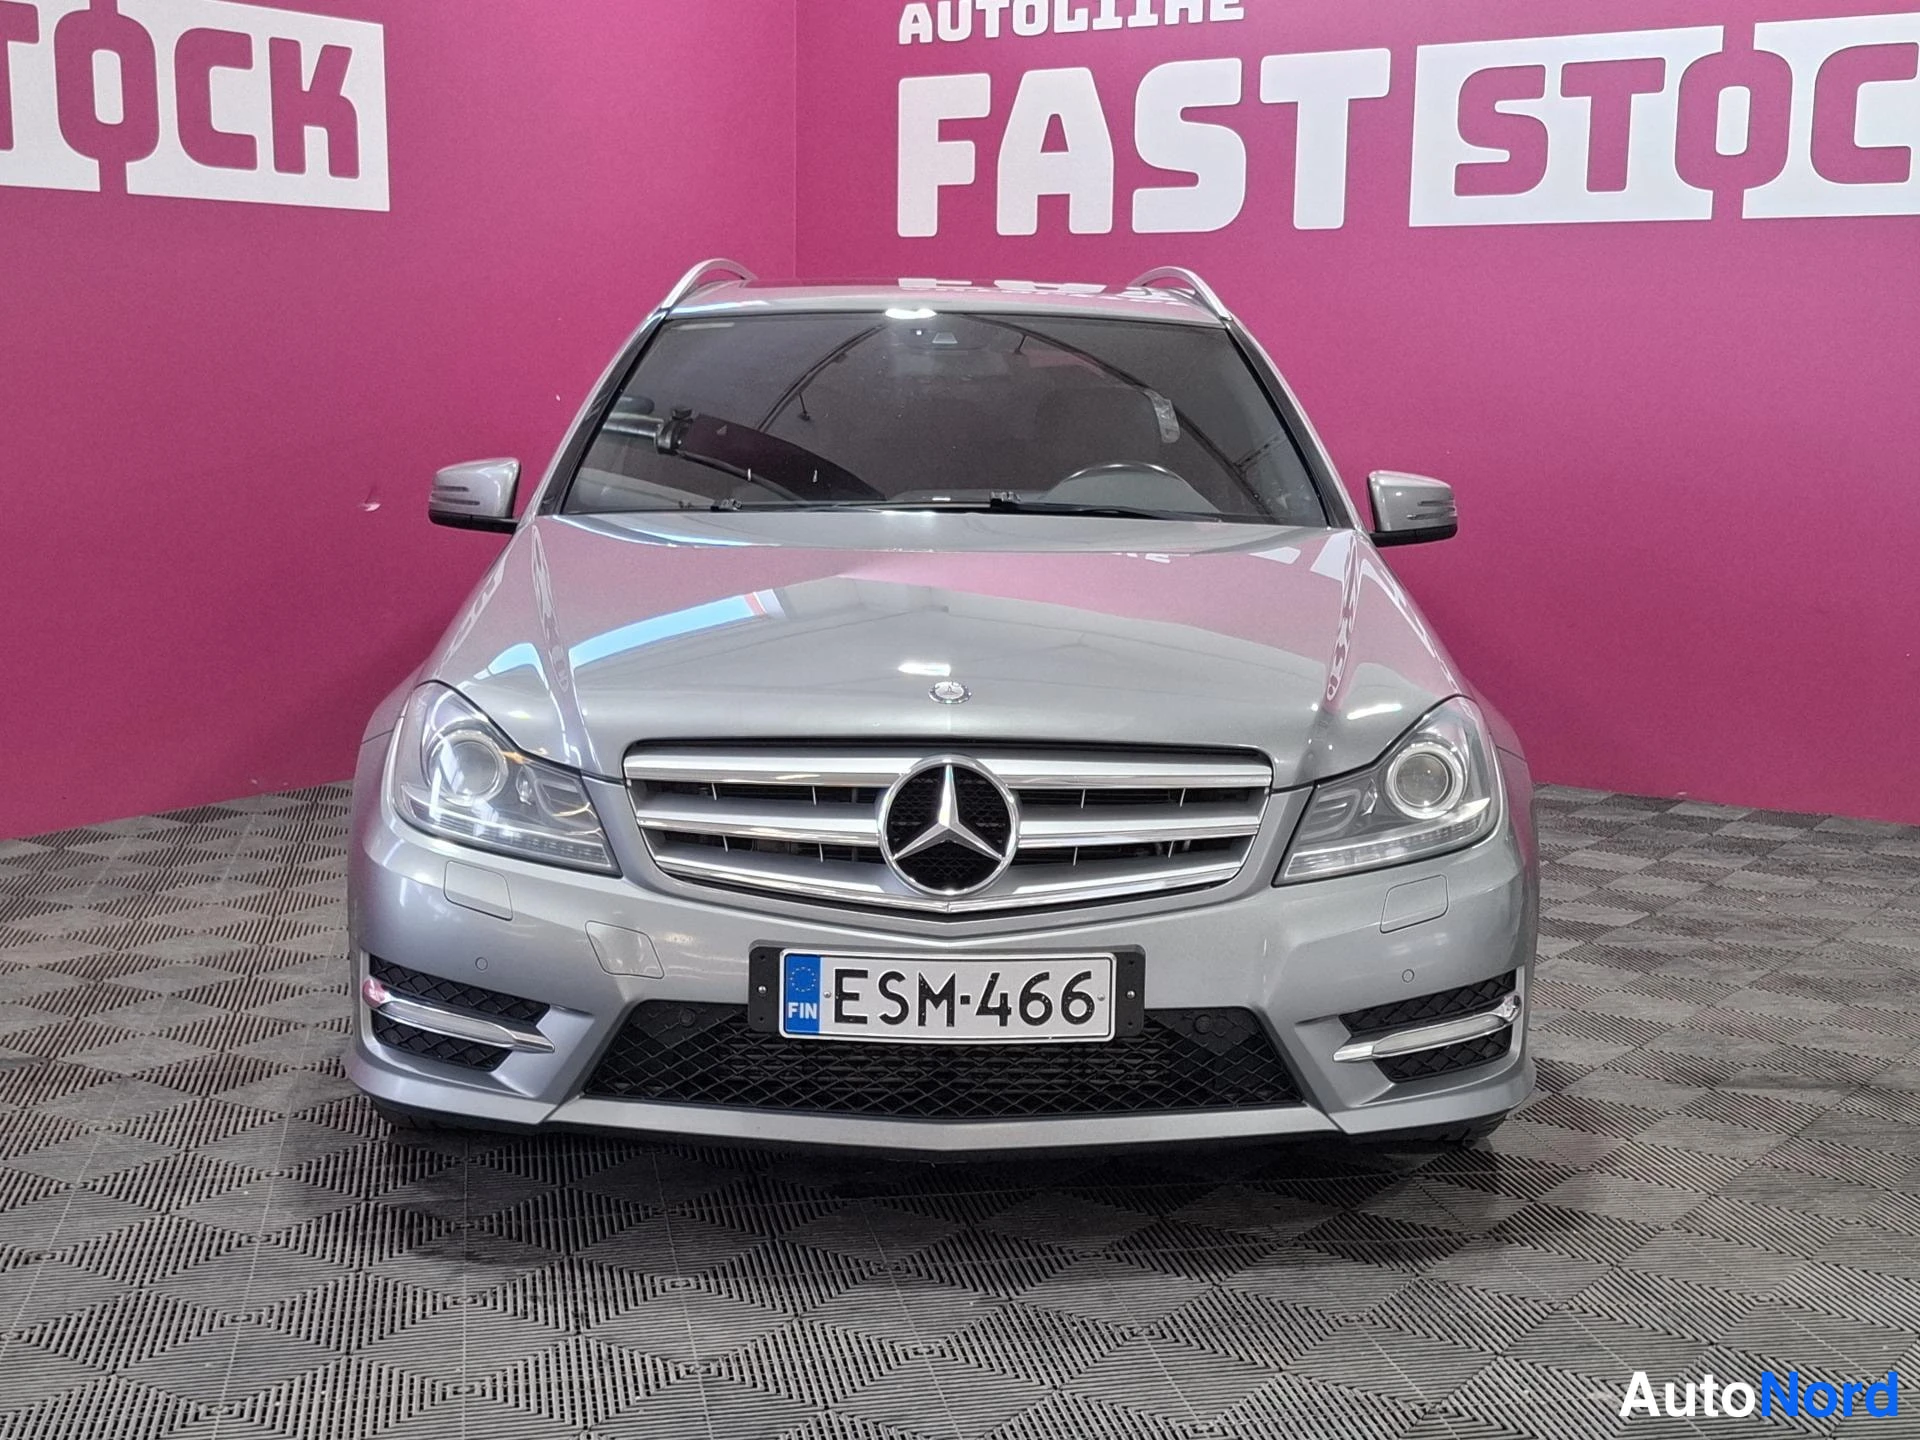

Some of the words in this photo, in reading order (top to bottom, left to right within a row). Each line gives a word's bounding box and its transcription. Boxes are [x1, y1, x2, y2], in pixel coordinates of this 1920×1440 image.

[897, 48, 1391, 238] FAST
[787, 1002, 818, 1020] FIN
[833, 968, 1096, 1028] ESM-466
